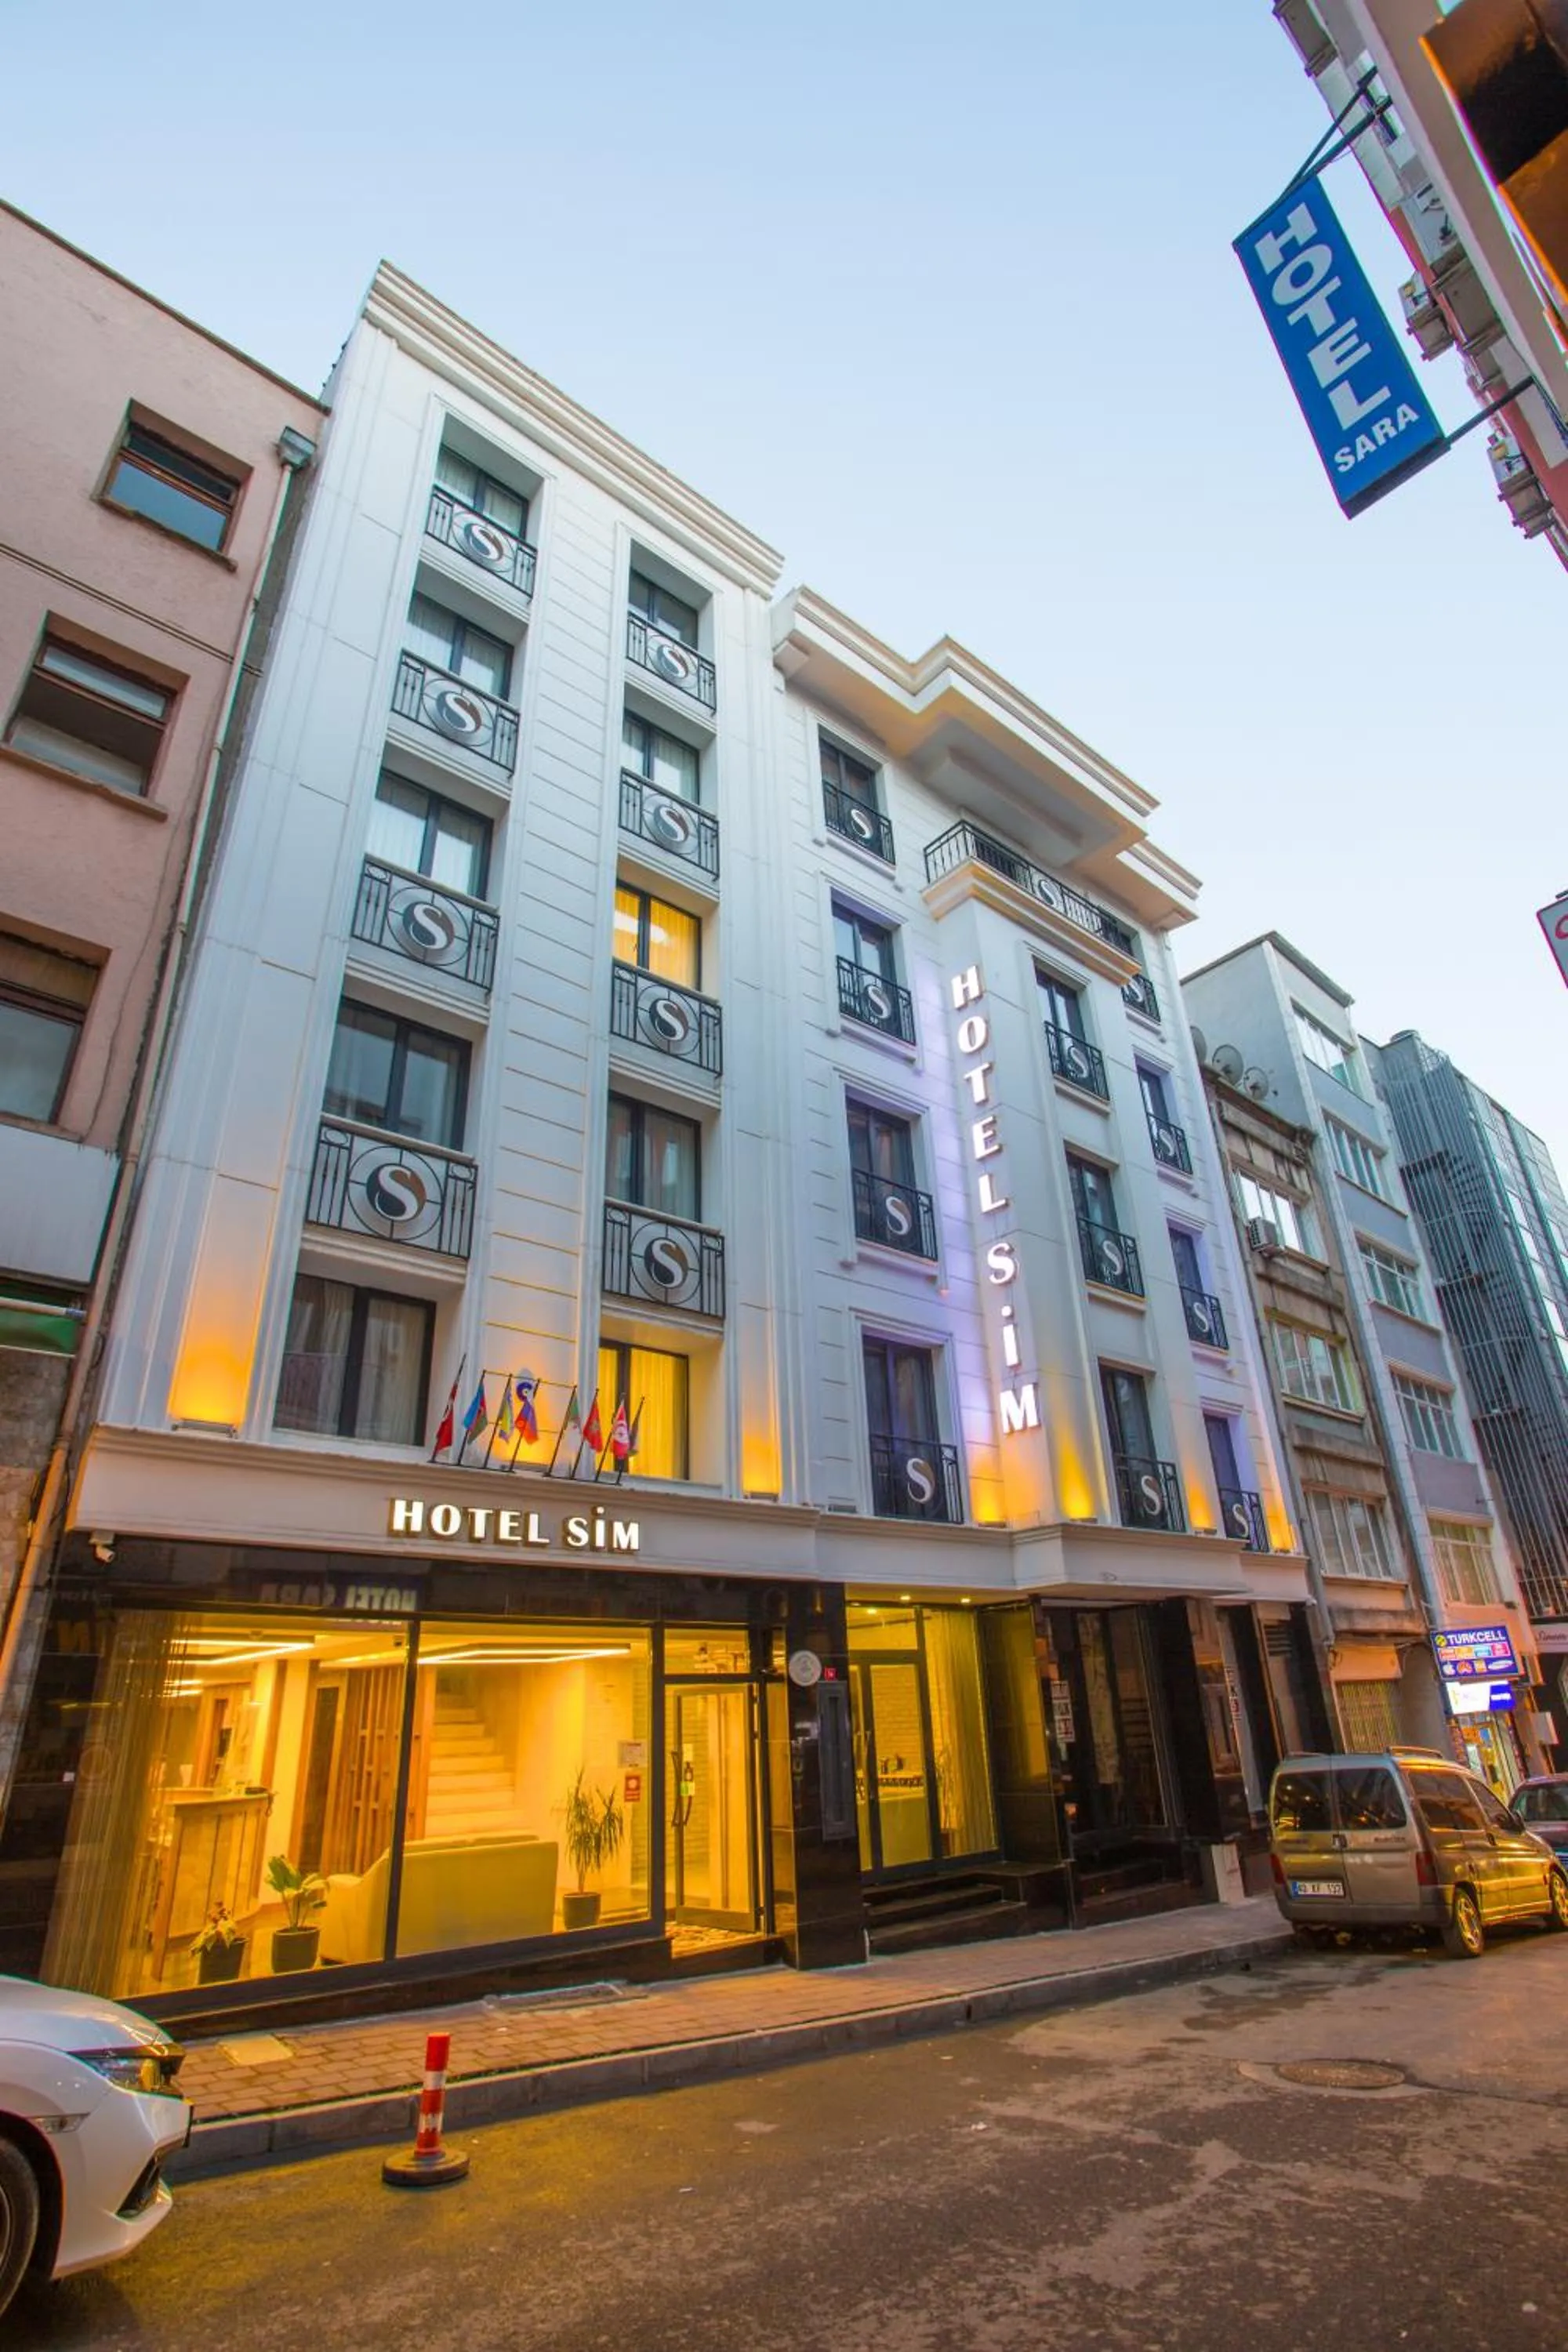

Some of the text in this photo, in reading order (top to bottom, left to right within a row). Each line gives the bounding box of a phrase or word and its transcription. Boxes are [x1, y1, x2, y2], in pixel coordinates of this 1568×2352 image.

[1254, 201, 1392, 431] HOTEL
[1334, 403, 1420, 472] SARA
[951, 965, 1009, 1214] HOTEL
[391, 1498, 550, 1544] HOTEL
[1446, 1630, 1505, 1645] TURKCELL
